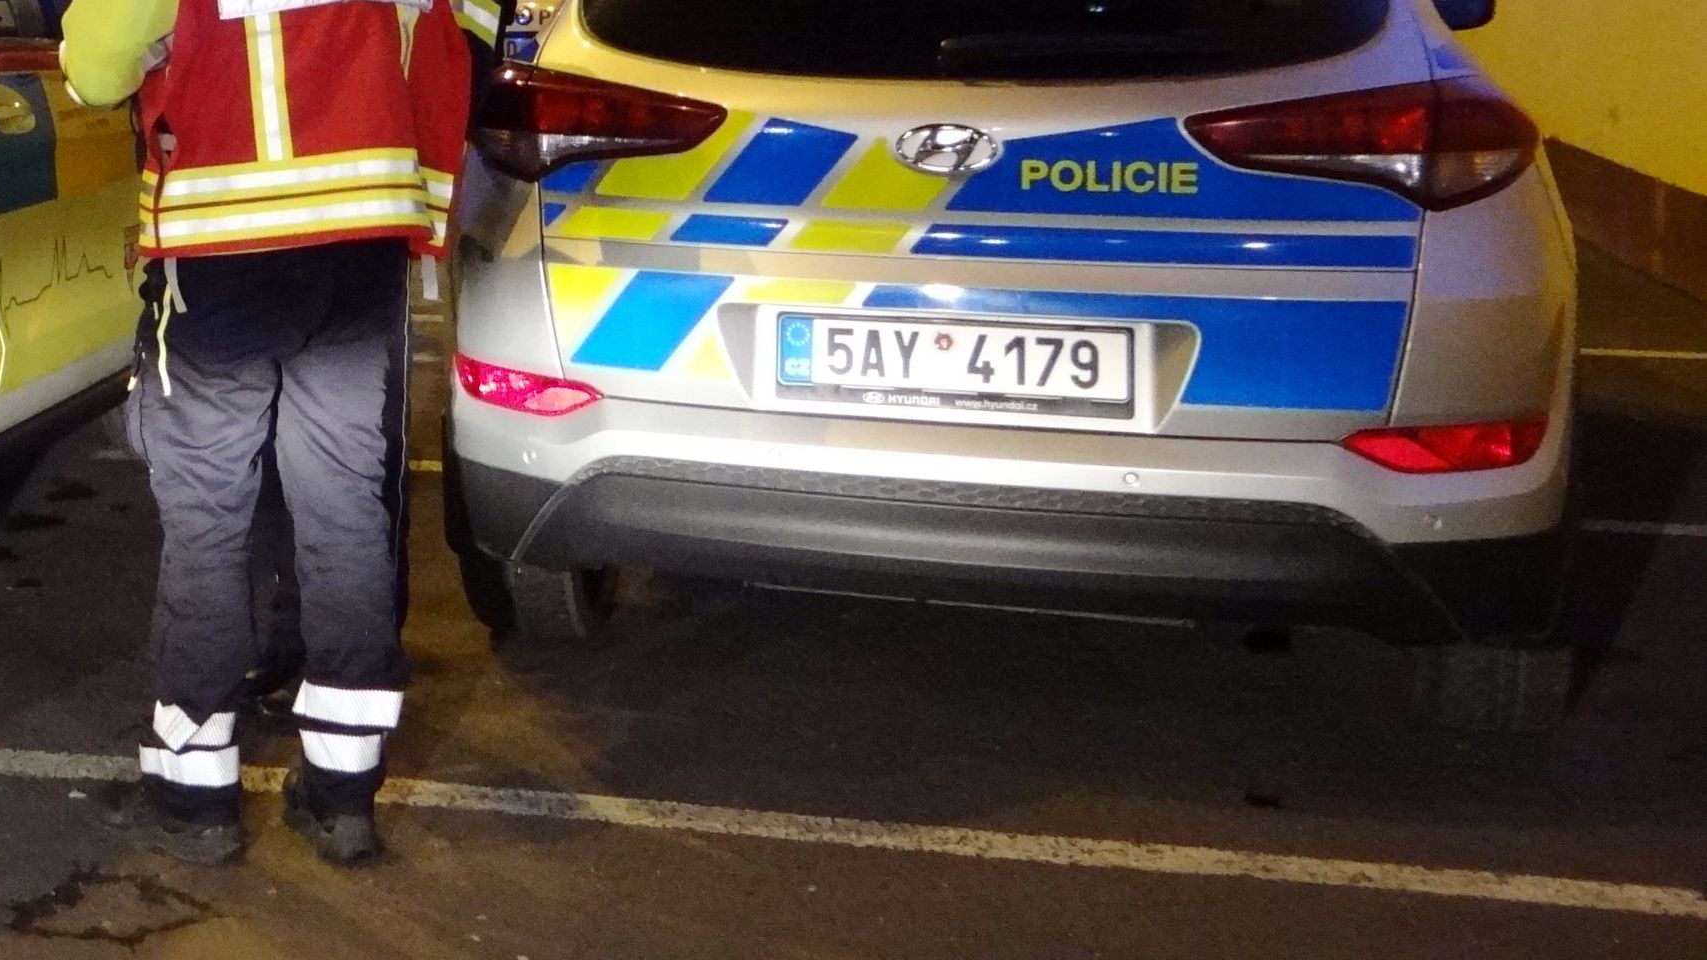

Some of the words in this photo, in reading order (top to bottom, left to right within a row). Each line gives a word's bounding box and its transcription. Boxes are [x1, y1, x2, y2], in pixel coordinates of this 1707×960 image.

[1021, 159, 1199, 194] POLICIE
[827, 327, 919, 380] 5AY
[967, 334, 1100, 390] 4179
[887, 394, 941, 407] HYUNDAI
